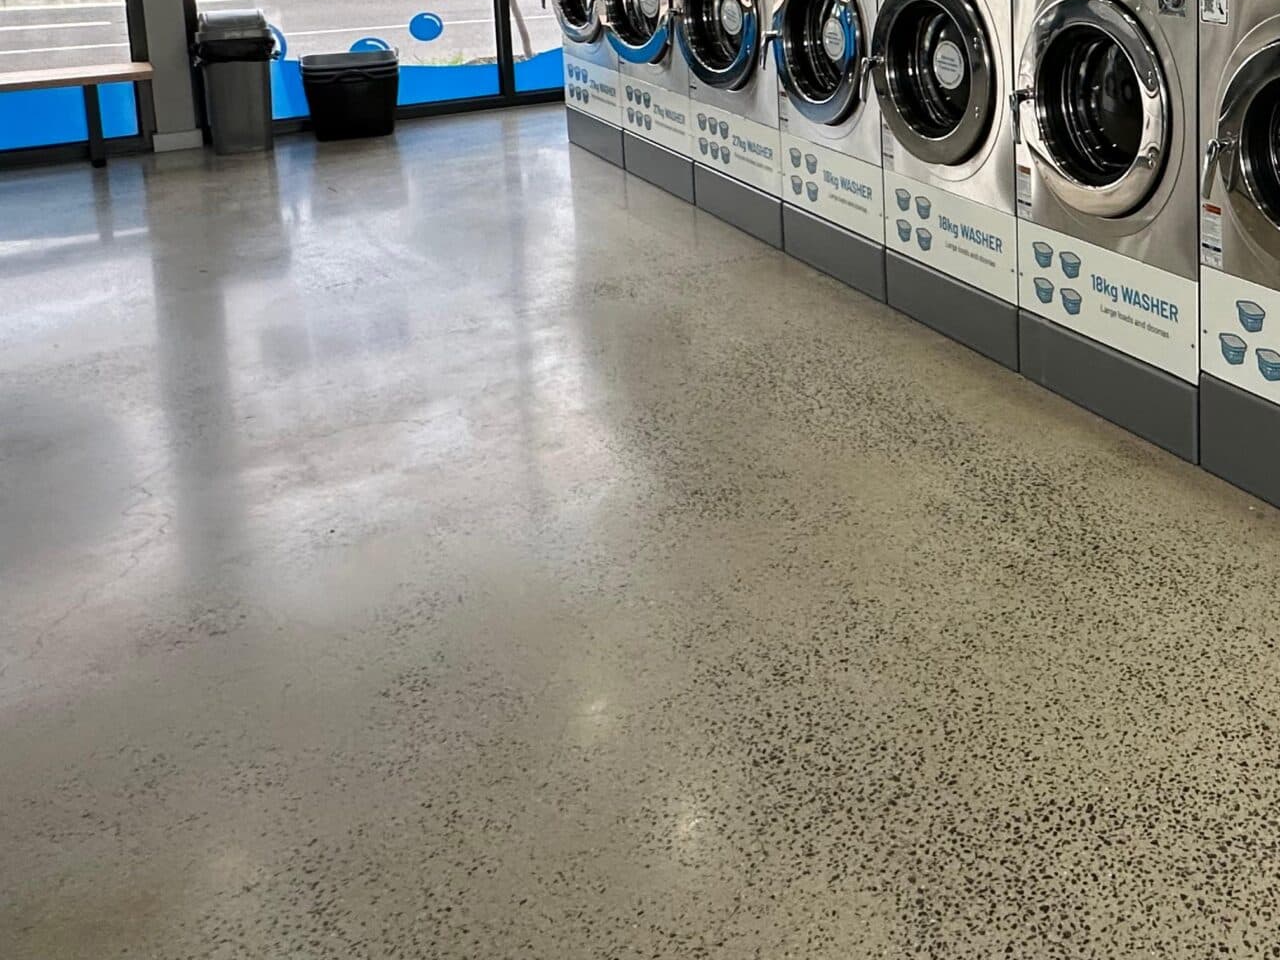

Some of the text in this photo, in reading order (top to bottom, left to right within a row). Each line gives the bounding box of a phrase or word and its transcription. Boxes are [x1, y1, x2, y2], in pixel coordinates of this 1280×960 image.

[840, 176, 873, 201] WASHER
[938, 214, 1003, 254] 18kg WASHER
[1091, 274, 1179, 322] 18kg WASHER
